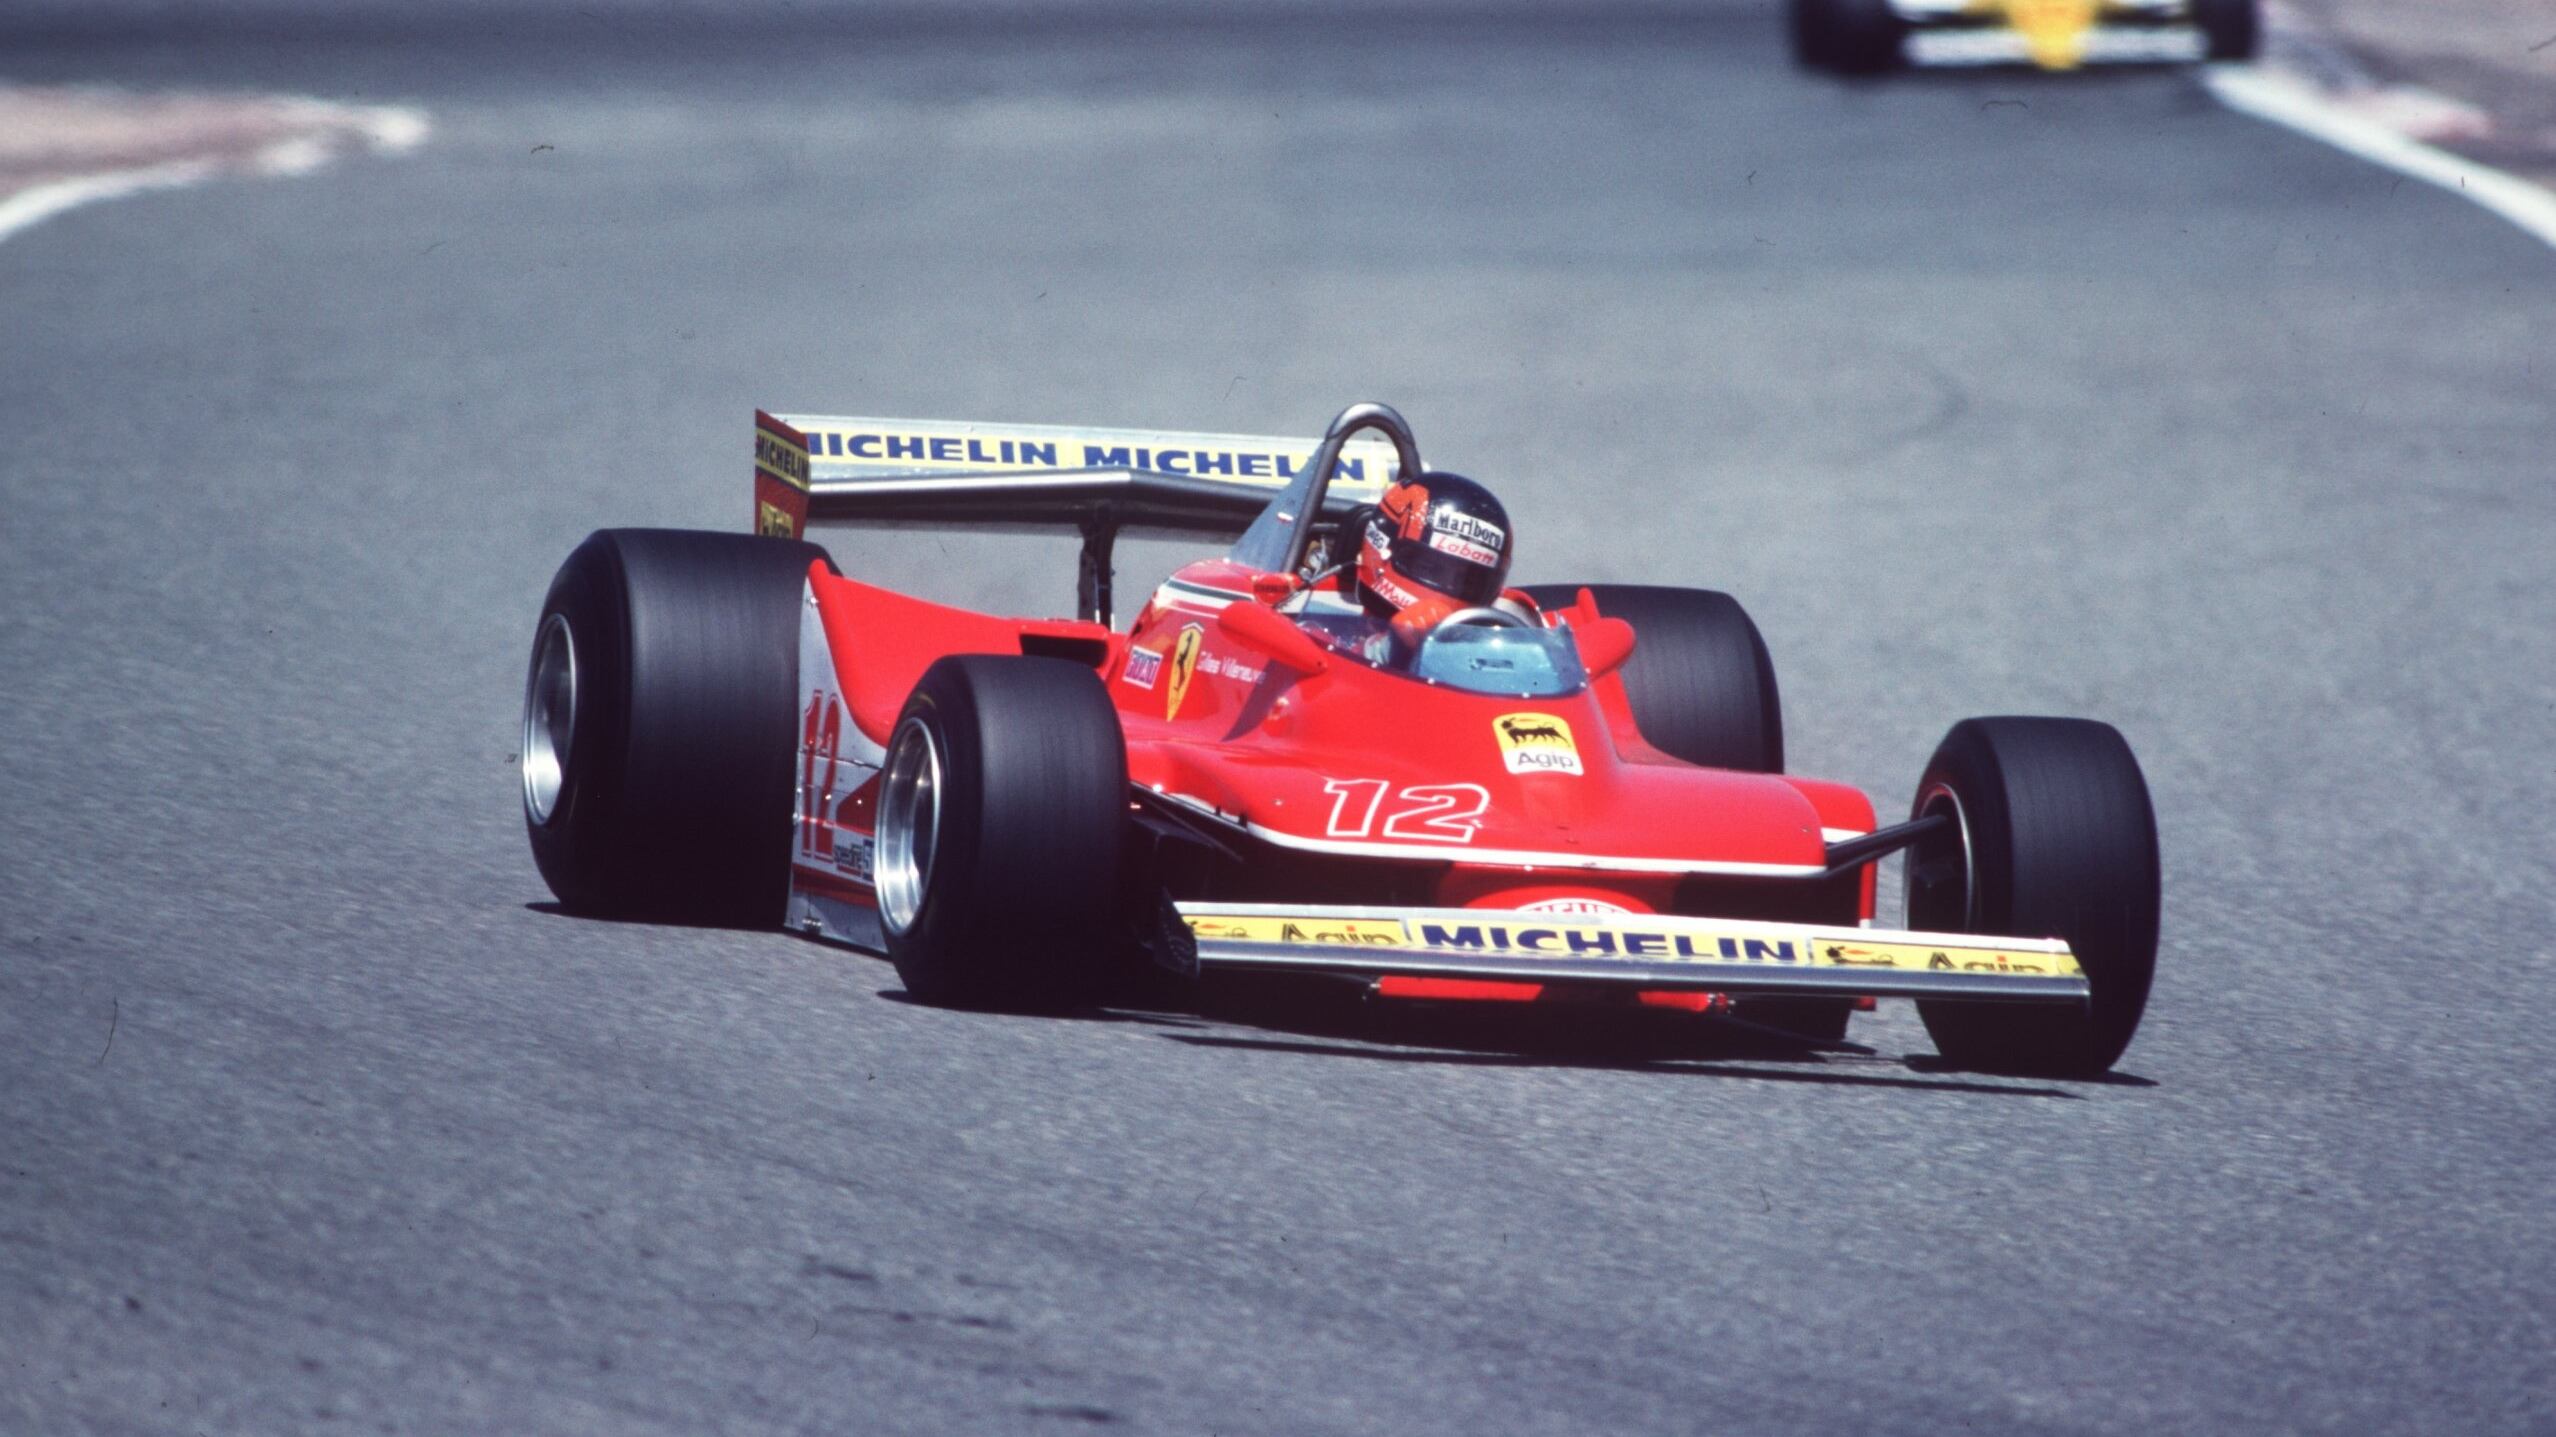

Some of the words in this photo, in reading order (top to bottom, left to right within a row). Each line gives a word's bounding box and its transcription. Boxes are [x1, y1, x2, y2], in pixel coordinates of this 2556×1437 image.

[1084, 446, 1364, 481] MICHELN
[1518, 751, 1574, 769] Agip
[1324, 777, 1491, 843] 12
[1421, 924, 1797, 961] MICHELIN
